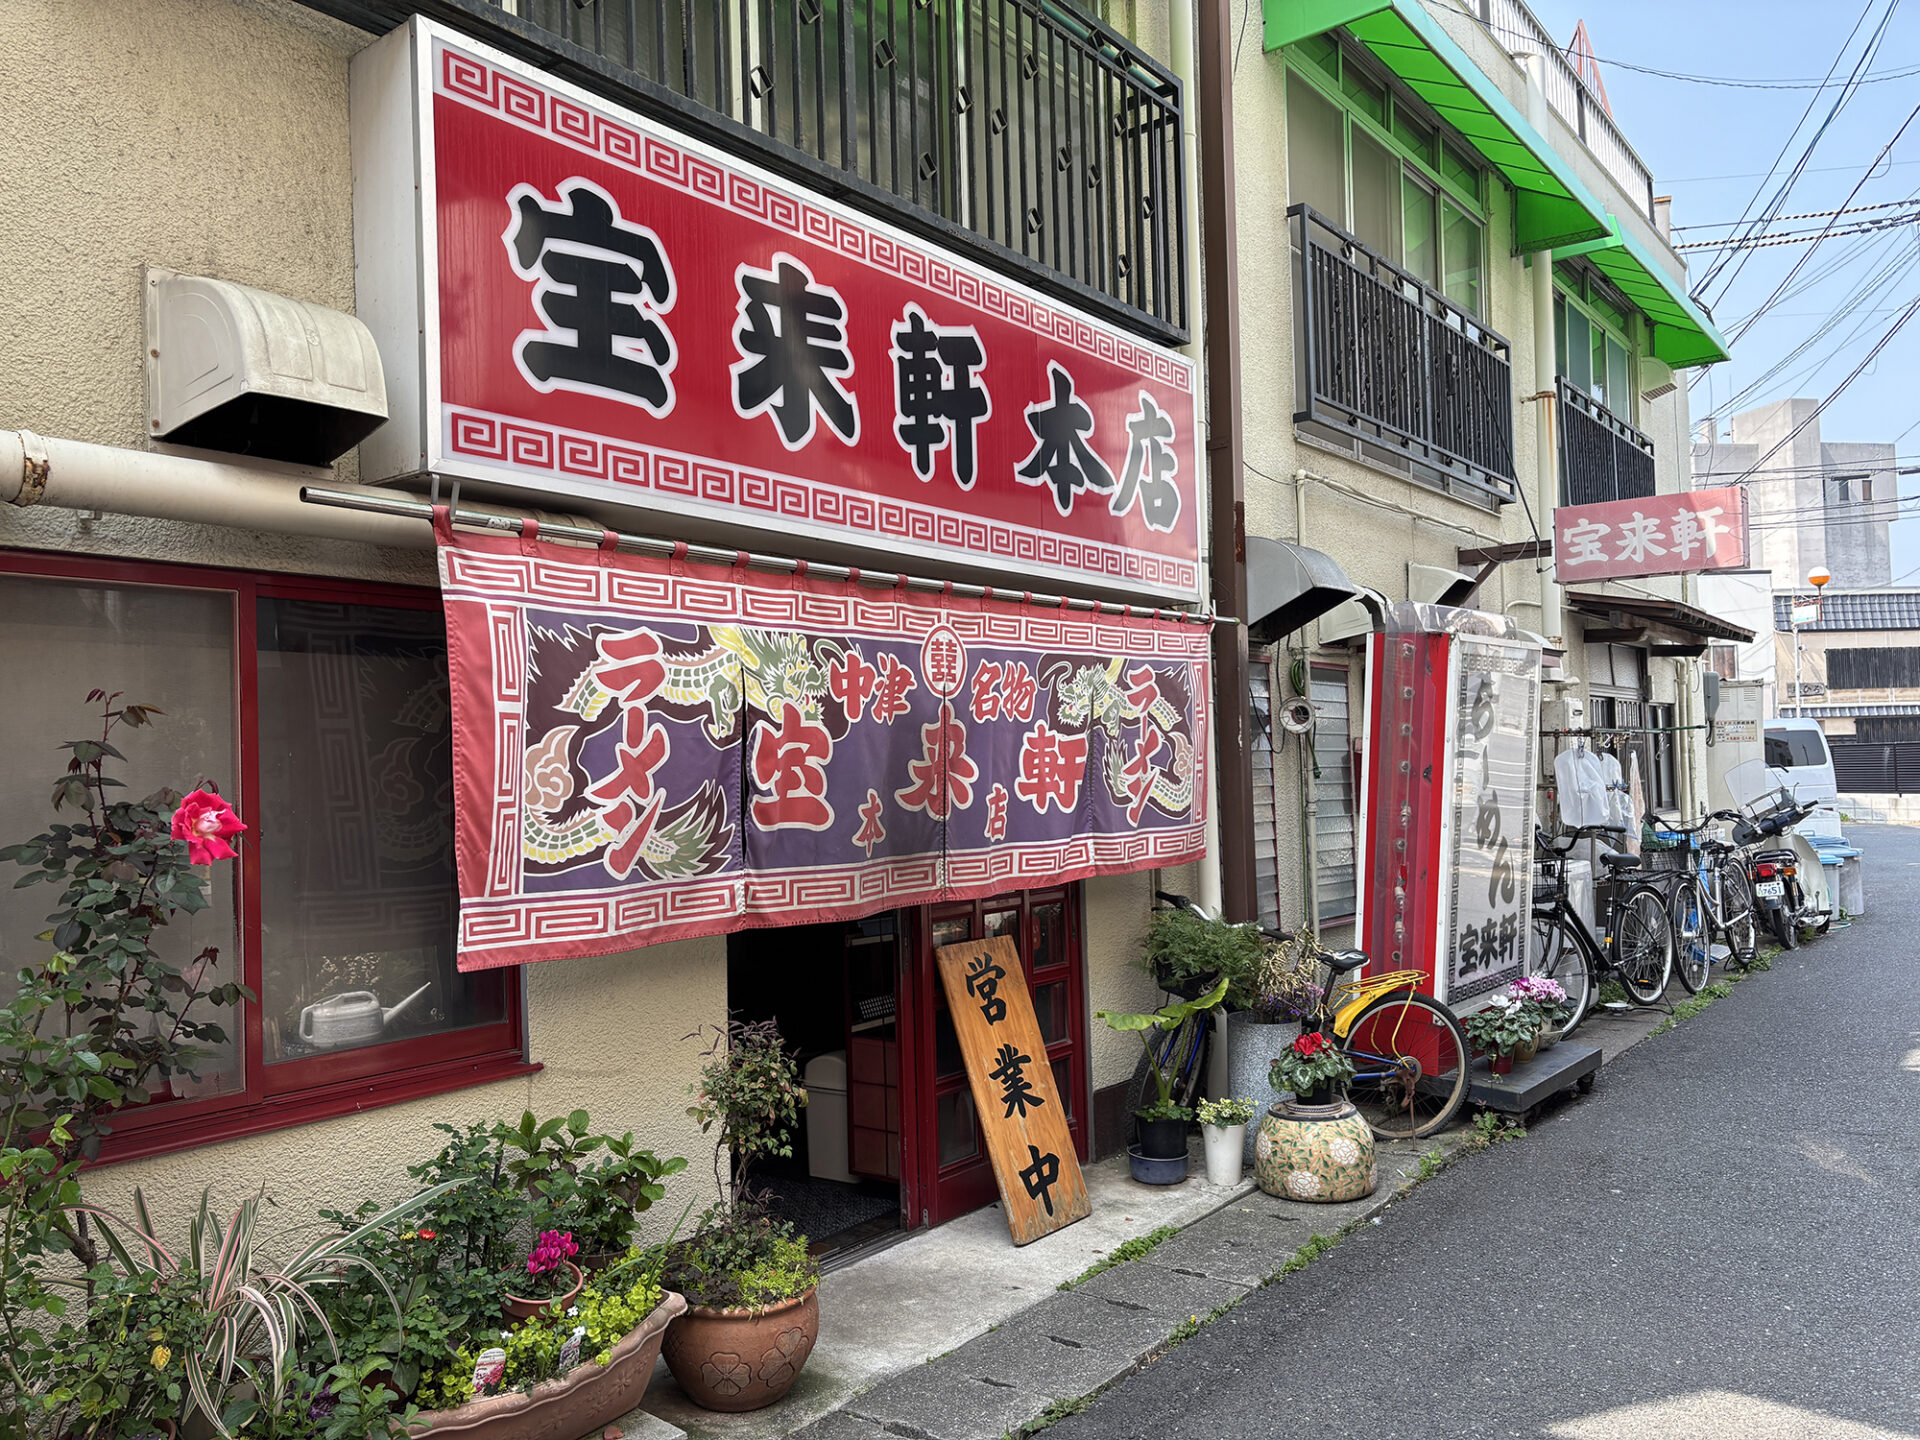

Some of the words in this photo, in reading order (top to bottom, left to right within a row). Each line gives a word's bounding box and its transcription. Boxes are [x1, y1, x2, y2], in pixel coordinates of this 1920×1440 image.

[503, 177, 1182, 531] 宝来軒本店
[1563, 506, 1730, 566] 宝来軒
[586, 628, 668, 879] ラーメン
[1122, 664, 1163, 827] ラーメン
[1470, 672, 1516, 909] らーめん
[1458, 912, 1518, 978] 宝来軒
[964, 951, 1060, 1217] 営業中
